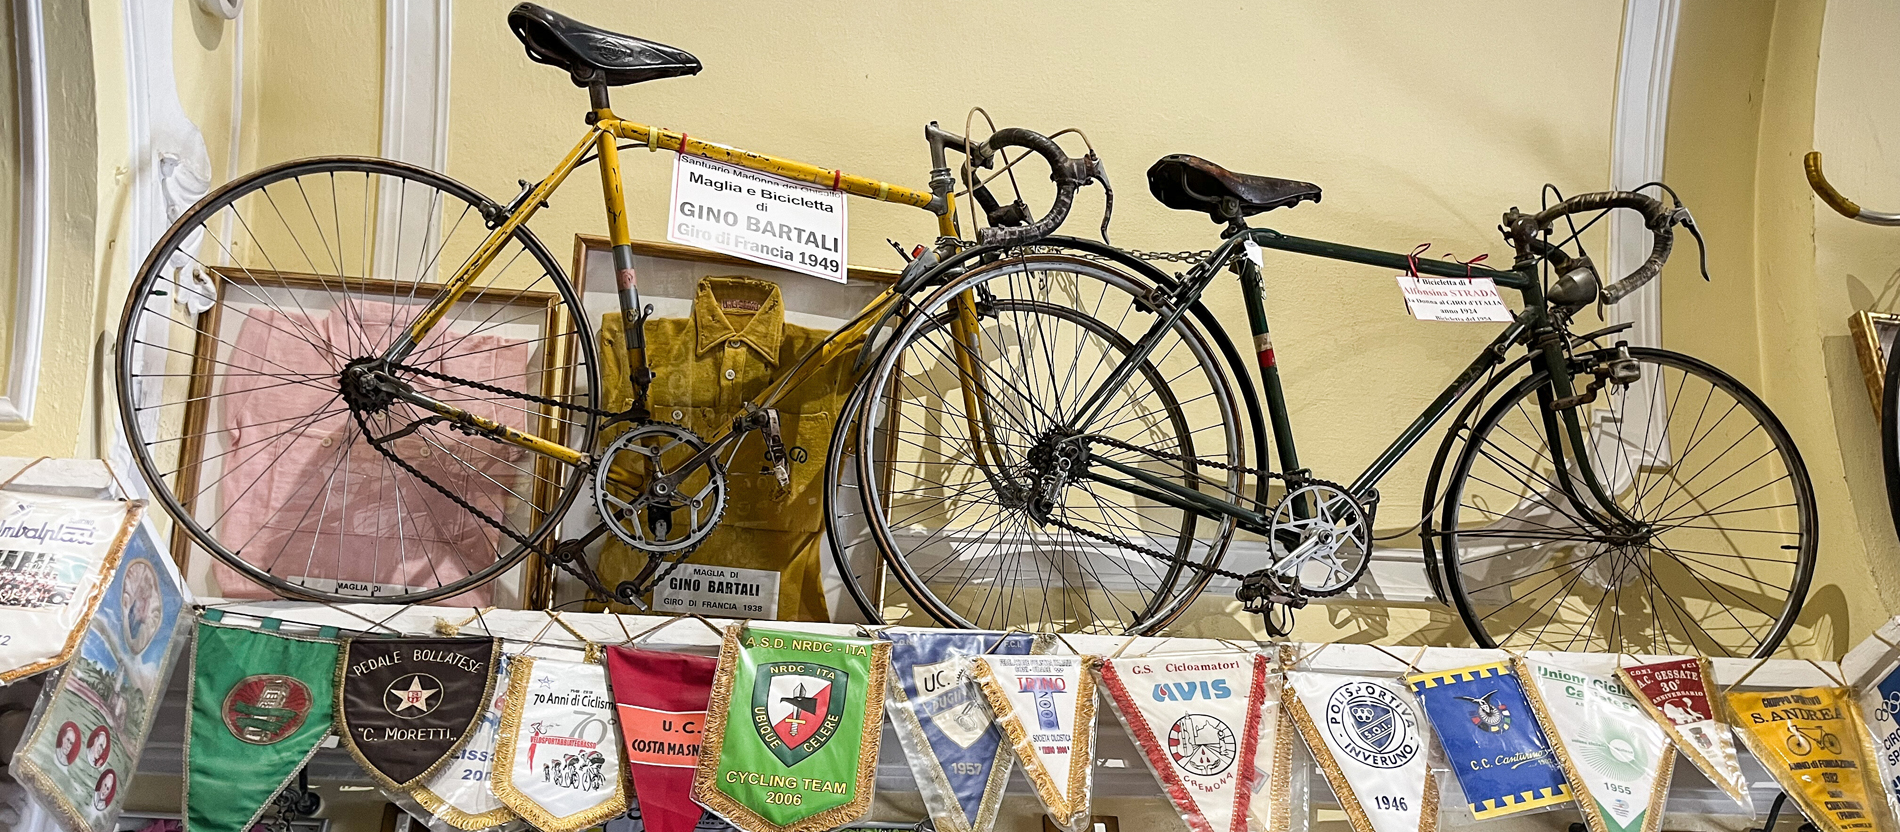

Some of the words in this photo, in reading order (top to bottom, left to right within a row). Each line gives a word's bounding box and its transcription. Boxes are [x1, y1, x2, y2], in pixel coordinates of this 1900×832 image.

[681, 154, 730, 174] Santuario
[733, 169, 779, 187] Madonna
[689, 171, 742, 192] Maglia
[746, 187, 756, 196] e
[760, 189, 834, 213] Bicicletta
[756, 201, 768, 212] di
[679, 201, 739, 227] GINO
[746, 215, 839, 253] BARTALI
[677, 222, 712, 241] Giro
[715, 231, 730, 246] di
[735, 235, 794, 262] Francia
[798, 251, 840, 273] 1949
[1421, 278, 1457, 286] Bicicletta
[1403, 287, 1448, 297] Alfonsina
[1450, 289, 1497, 297] STRADA
[693, 568, 725, 578] MAGLIA
[337, 582, 369, 592] MAGLIA
[373, 585, 382, 593] DI
[669, 577, 700, 592] GINO
[707, 580, 760, 597] BARTALI
[663, 597, 684, 606] GIRO
[688, 599, 697, 607] DI
[702, 600, 737, 610] FRANCIA
[743, 604, 763, 612] 1938
[0, 634, 11, 646] 2
[746, 637, 787, 650] A.S.D.
[791, 639, 833, 653] NRDC
[845, 644, 868, 658] ITA
[353, 651, 402, 677] PEDALE
[413, 649, 484, 675] BOLLATESE
[769, 664, 805, 675] NRDC
[815, 666, 836, 680] ITA
[1132, 664, 1154, 675] G.S.
[1165, 660, 1240, 673] Cicloamatori
[924, 670, 951, 692] U.C.
[1016, 676, 1066, 691] TRINO
[1537, 665, 1586, 685] Unione
[1636, 675, 1654, 689] A.C.
[1654, 669, 1699, 681] GESSATE
[1152, 678, 1232, 703] AVIS
[1660, 679, 1680, 693] 30°
[533, 693, 546, 706] 70
[546, 692, 570, 706] Anni
[570, 694, 580, 706] di
[1652, 690, 1704, 705] ANNIVERSARIO
[1761, 696, 1792, 708] GRUPPO
[1330, 685, 1415, 729] POLISPORTIVA
[753, 706, 783, 750] UBIQUE
[803, 713, 839, 753] CELERE
[1364, 723, 1392, 740] S.O.I.
[632, 738, 667, 756] COSTA
[667, 743, 700, 757] MASN
[1344, 742, 1414, 767] INVERUNO
[950, 761, 982, 776] 1957
[1470, 758, 1494, 771] C.C.
[1495, 749, 1544, 766] Canturino
[725, 770, 797, 790] CYCLING
[801, 778, 847, 795] TEAM
[1183, 771, 1234, 793] CREMONA
[1604, 782, 1632, 795] 1955
[765, 790, 803, 806] 2006
[1374, 795, 1408, 812] 1946
